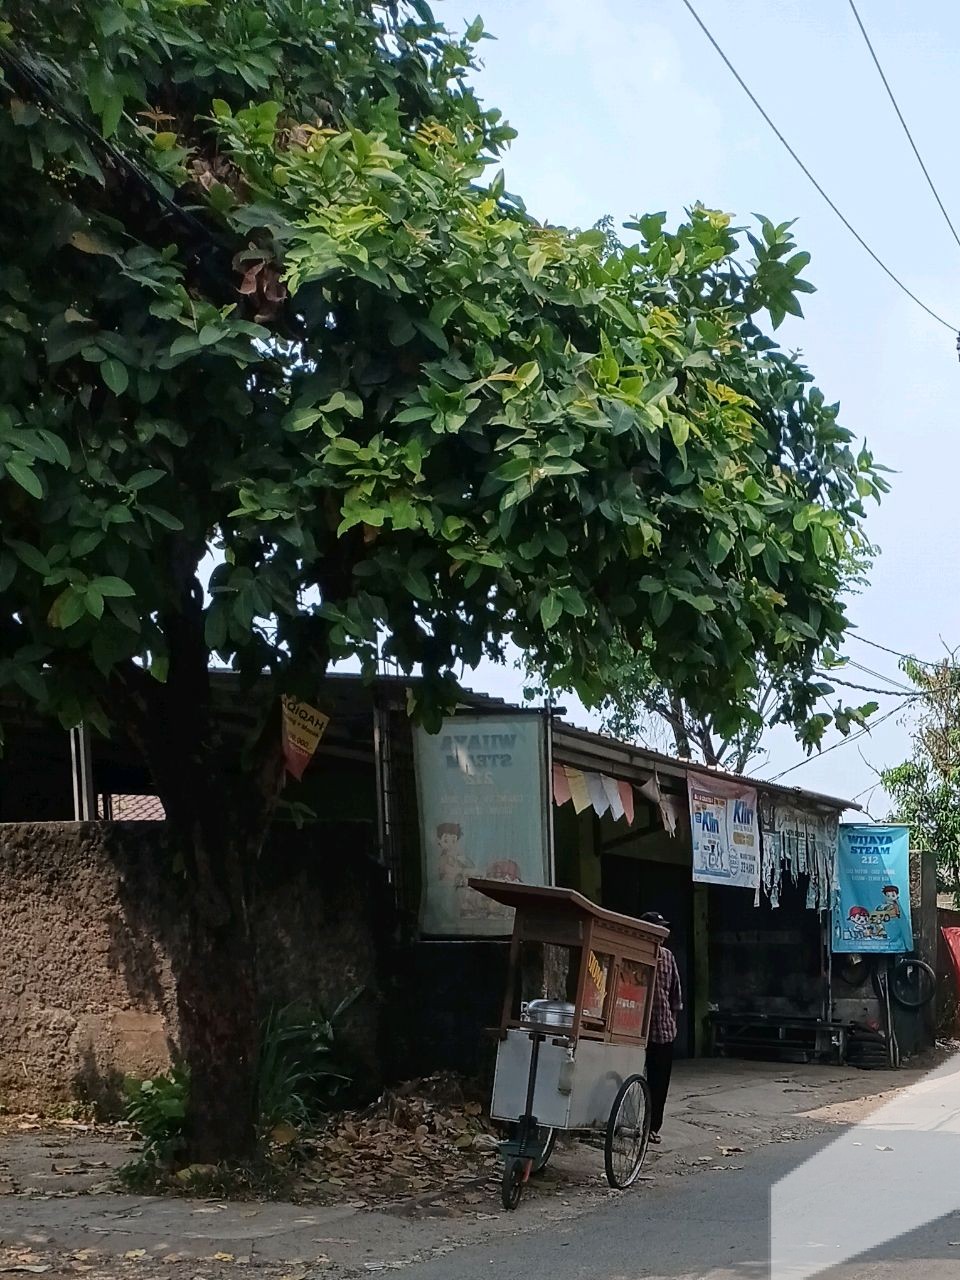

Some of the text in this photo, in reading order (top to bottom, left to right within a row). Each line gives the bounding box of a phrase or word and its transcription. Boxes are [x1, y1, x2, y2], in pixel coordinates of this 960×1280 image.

[847, 834, 894, 845] WIJAYA
[850, 846, 891, 855] STEAM
[861, 855, 880, 864] 212
